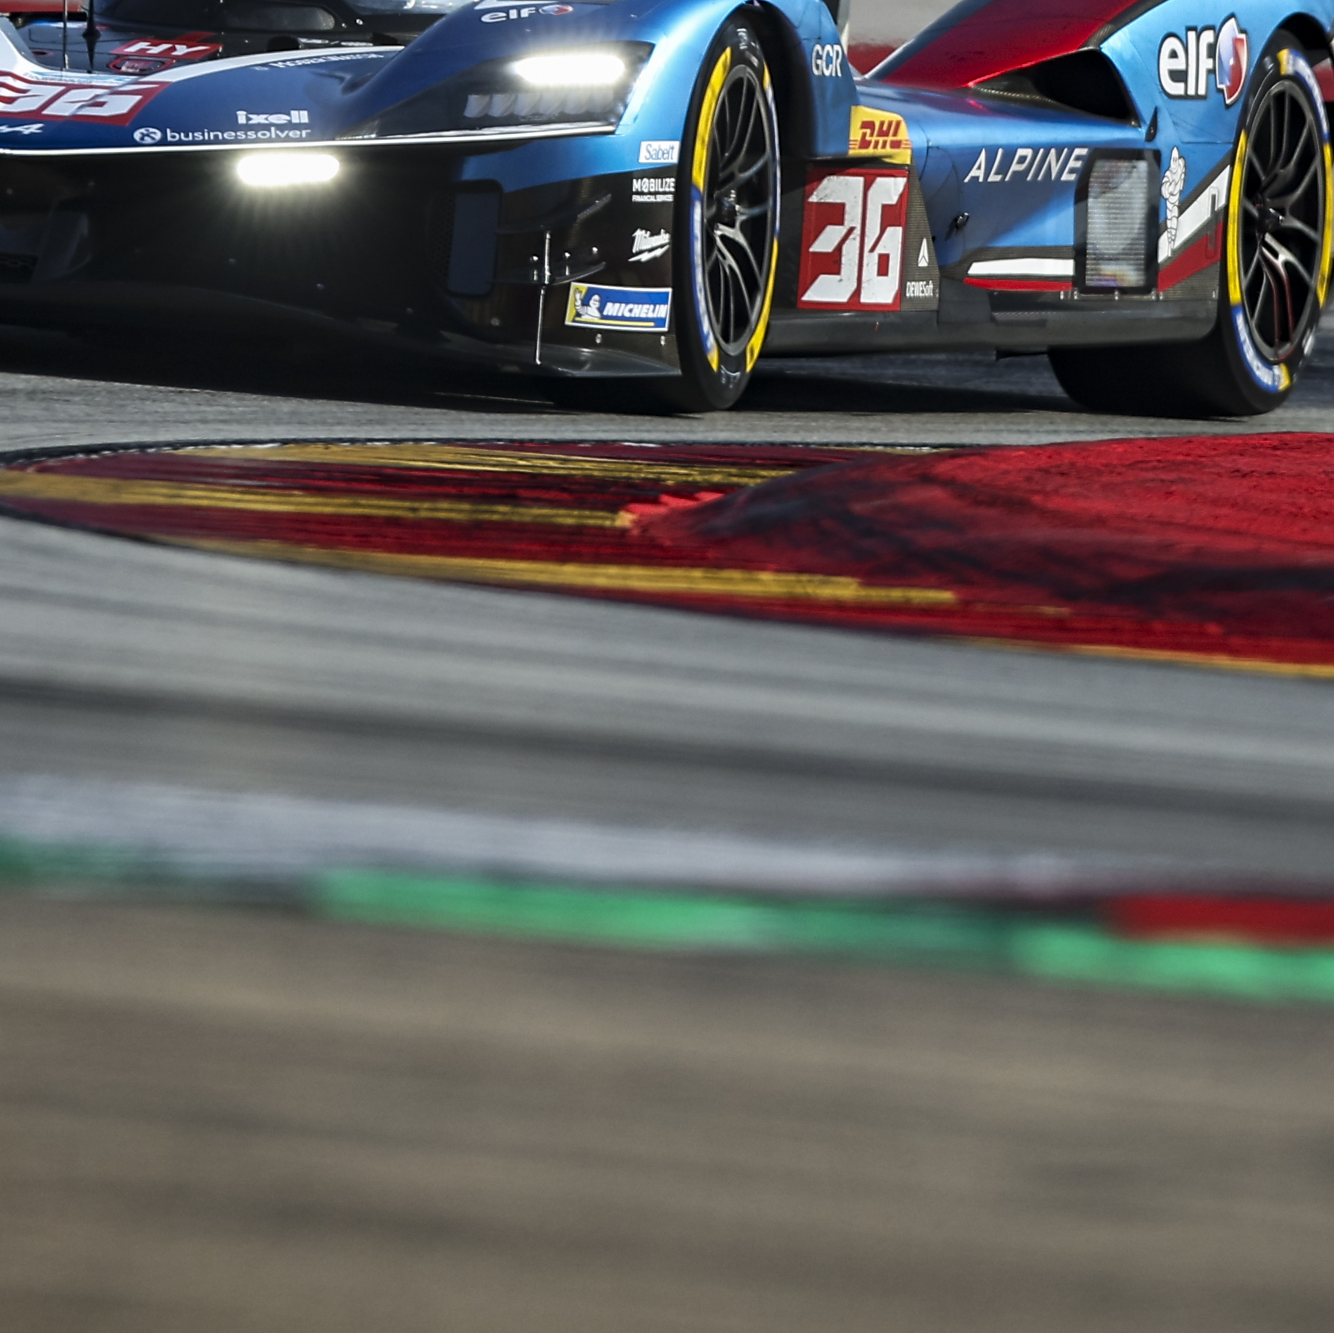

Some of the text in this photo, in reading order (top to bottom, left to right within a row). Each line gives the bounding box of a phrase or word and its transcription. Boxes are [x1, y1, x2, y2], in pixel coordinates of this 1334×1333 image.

[481, 7, 536, 23] elf
[124, 41, 210, 56] HY
[812, 44, 843, 77] GCR
[1159, 29, 1215, 96] elf
[236, 109, 310, 125] ixell
[167, 126, 310, 142] businessolver
[858, 120, 903, 150] DHL
[644, 143, 675, 161] Sabelt
[964, 147, 1089, 183] ALPINE
[801, 175, 908, 304] 36
[603, 301, 667, 318] MICHELIN
